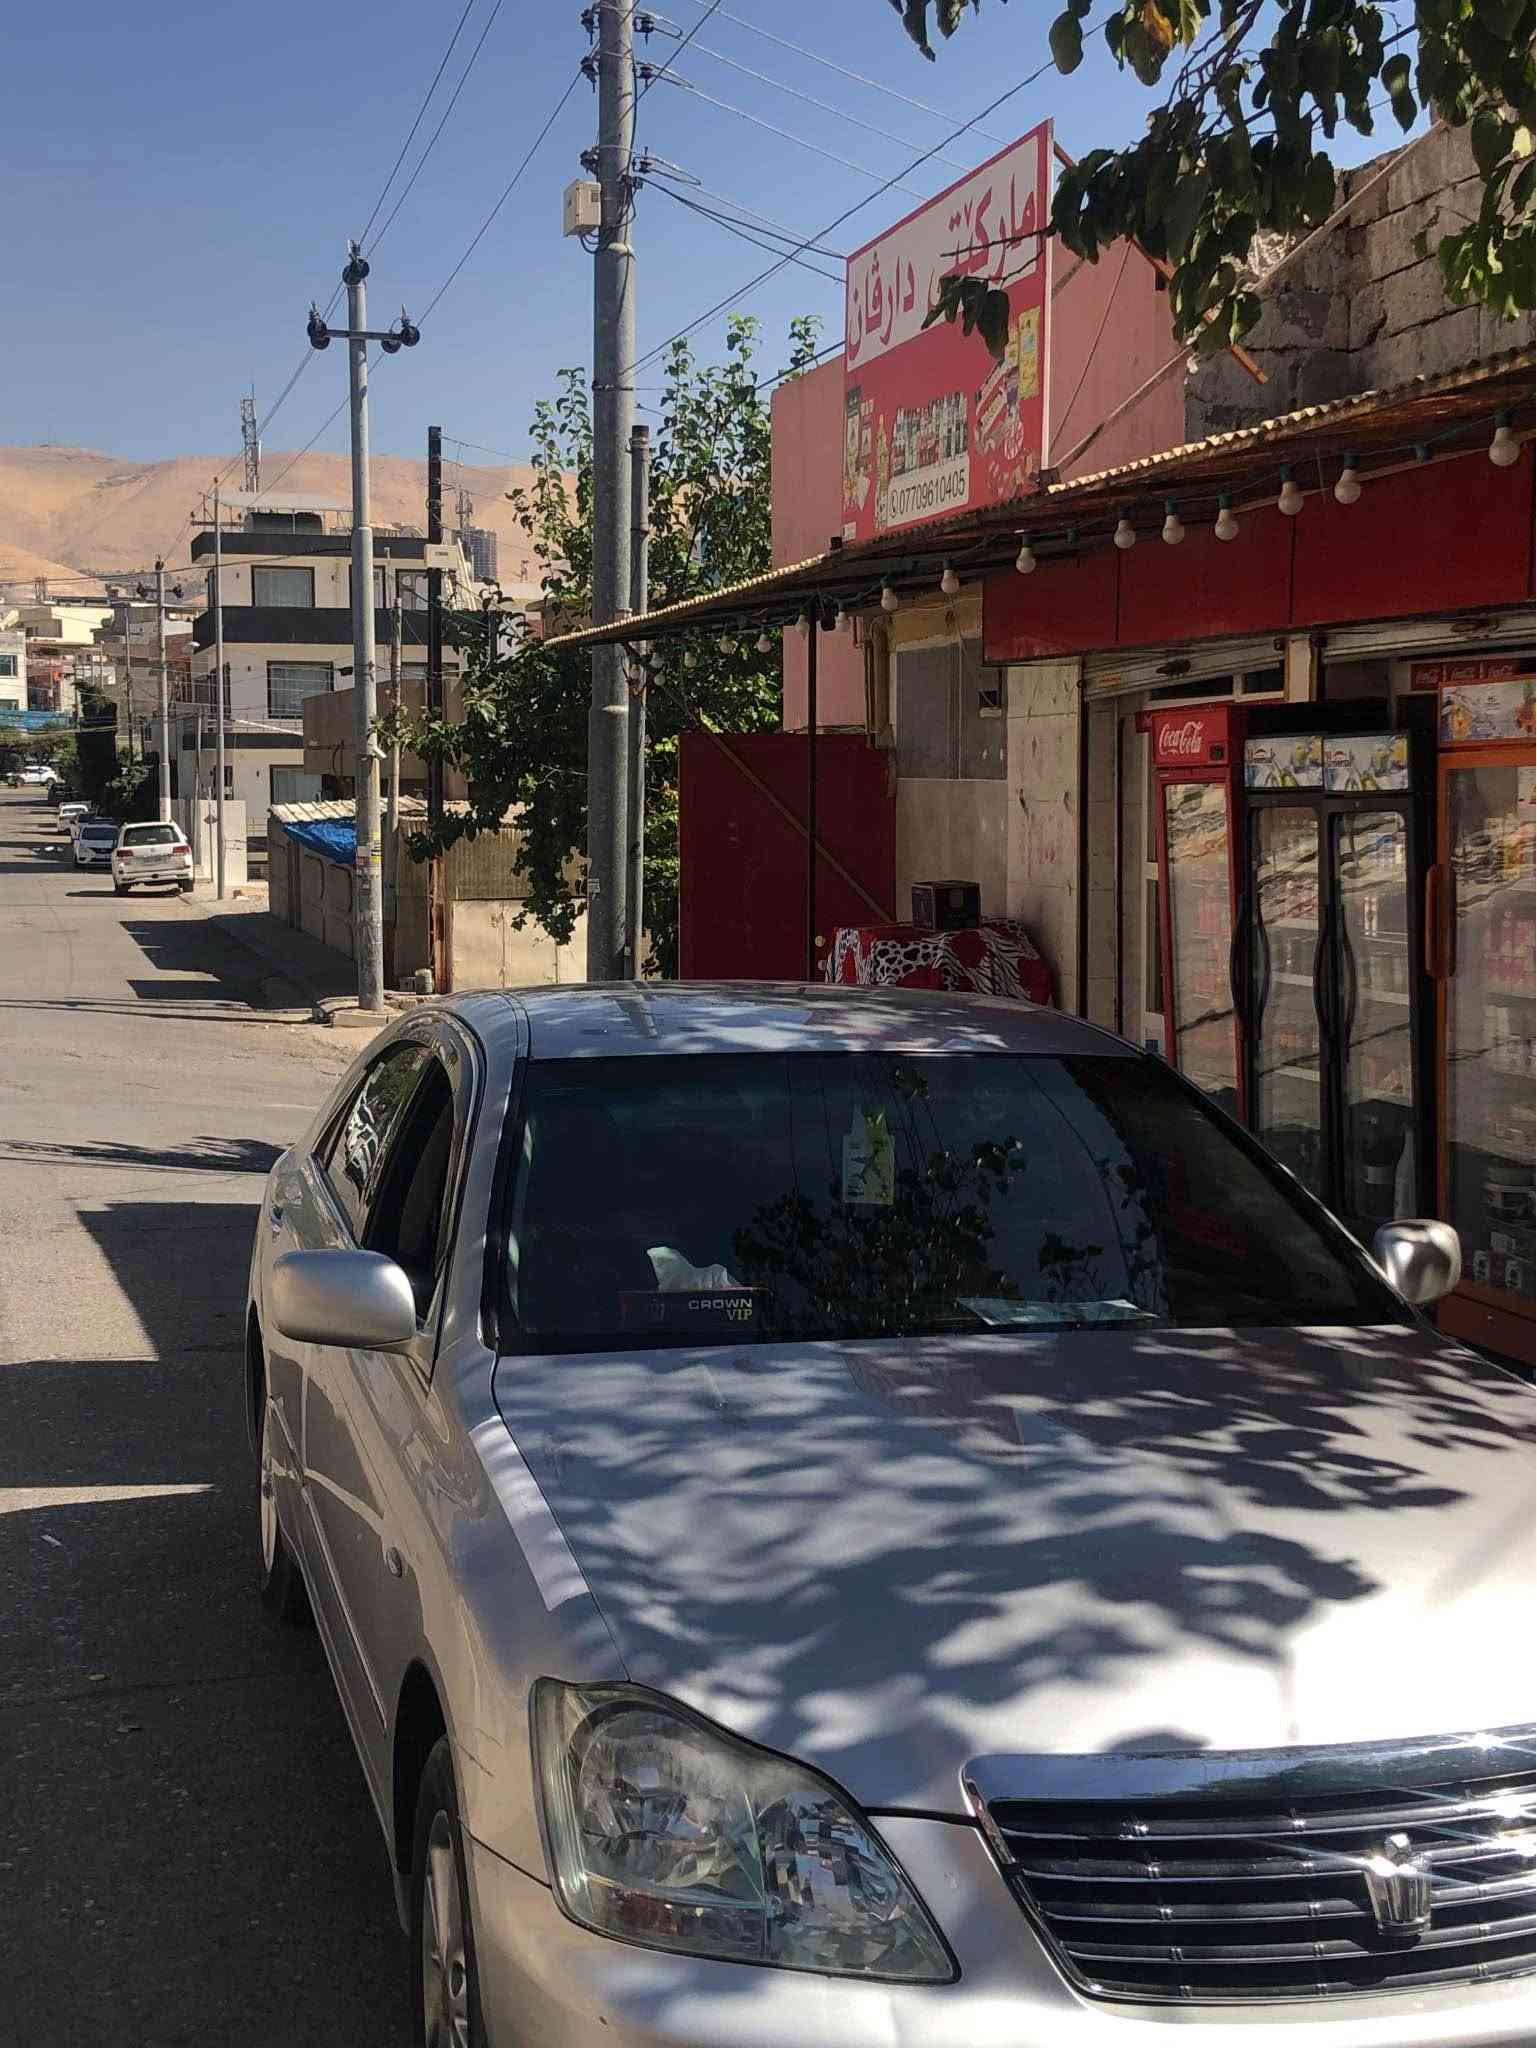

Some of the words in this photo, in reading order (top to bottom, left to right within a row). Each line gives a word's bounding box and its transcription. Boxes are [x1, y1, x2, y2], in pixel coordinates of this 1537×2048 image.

[900, 469, 965, 512] 07709610405
[688, 1298, 753, 1310] CROWN
[726, 1309, 753, 1321] VIP
